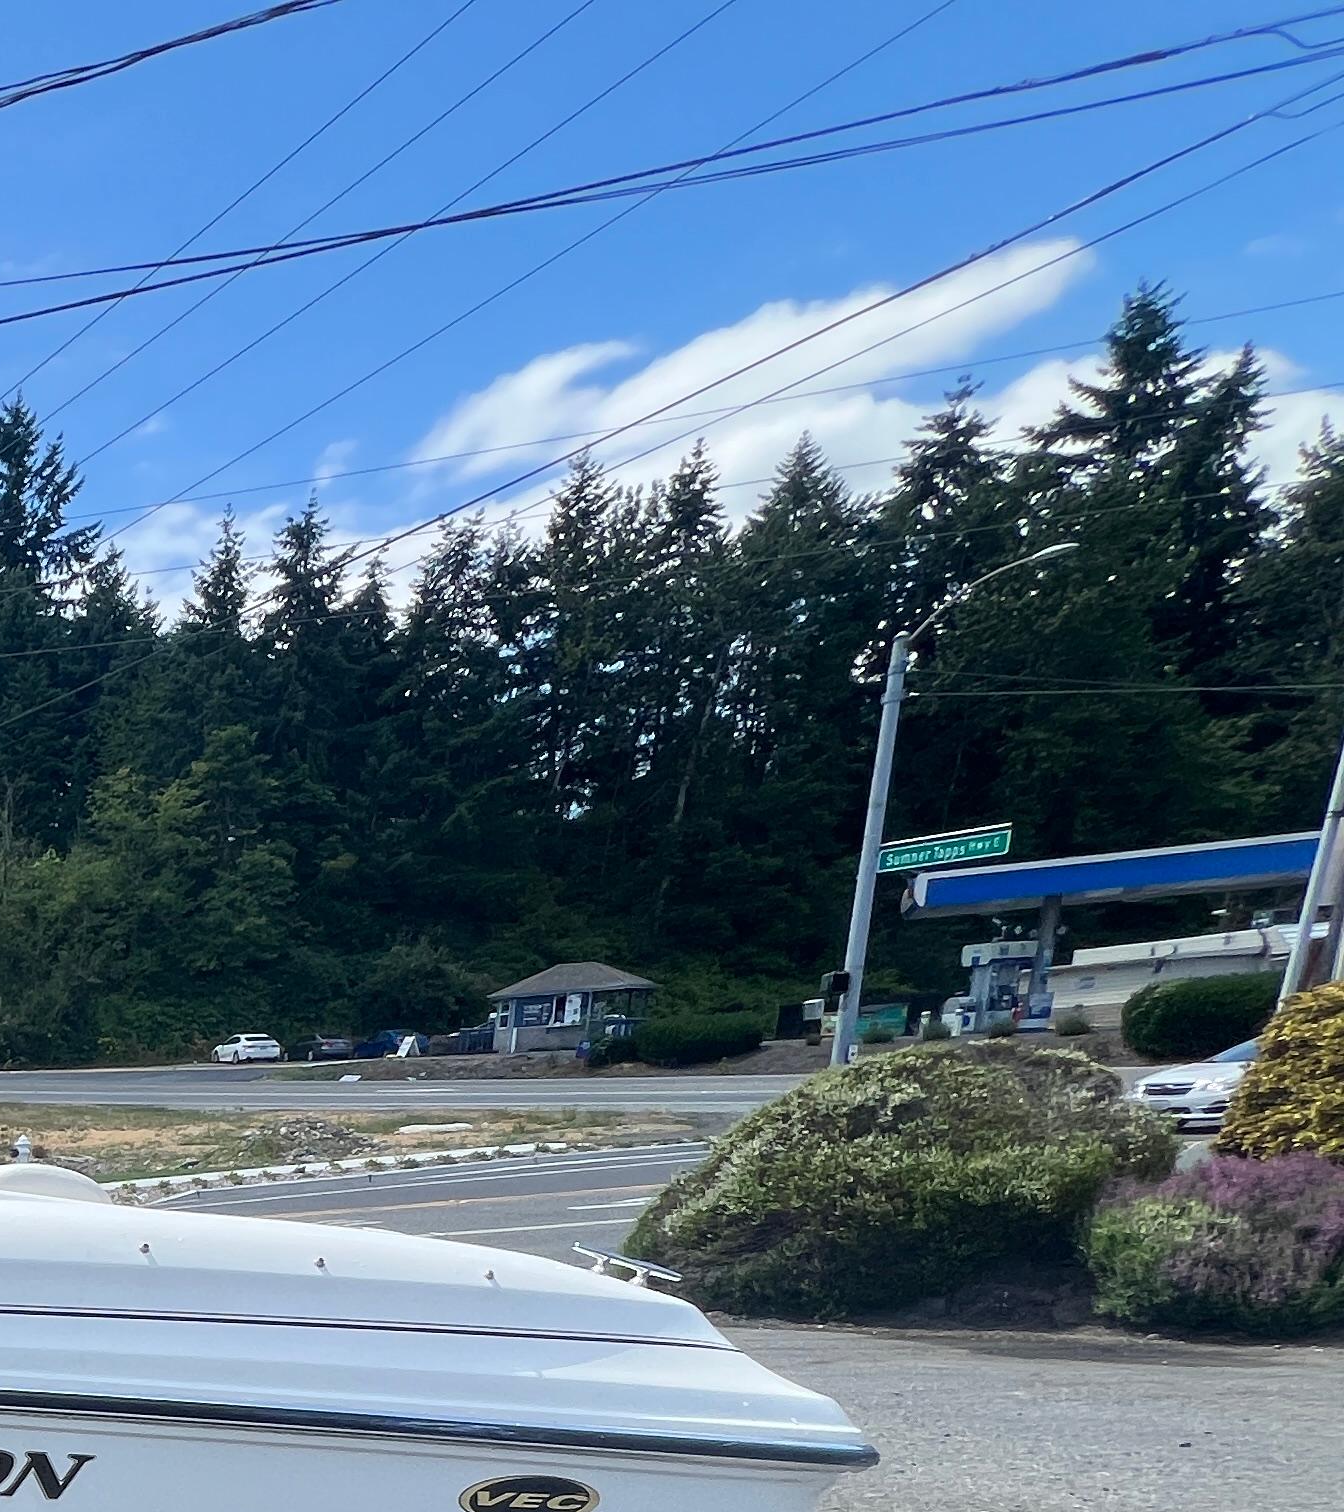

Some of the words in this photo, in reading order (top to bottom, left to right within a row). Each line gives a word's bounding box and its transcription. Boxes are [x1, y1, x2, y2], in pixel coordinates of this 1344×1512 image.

[885, 850, 931, 867] Sumner
[933, 845, 966, 863] Tapps
[475, 1490, 591, 1511] VEC
